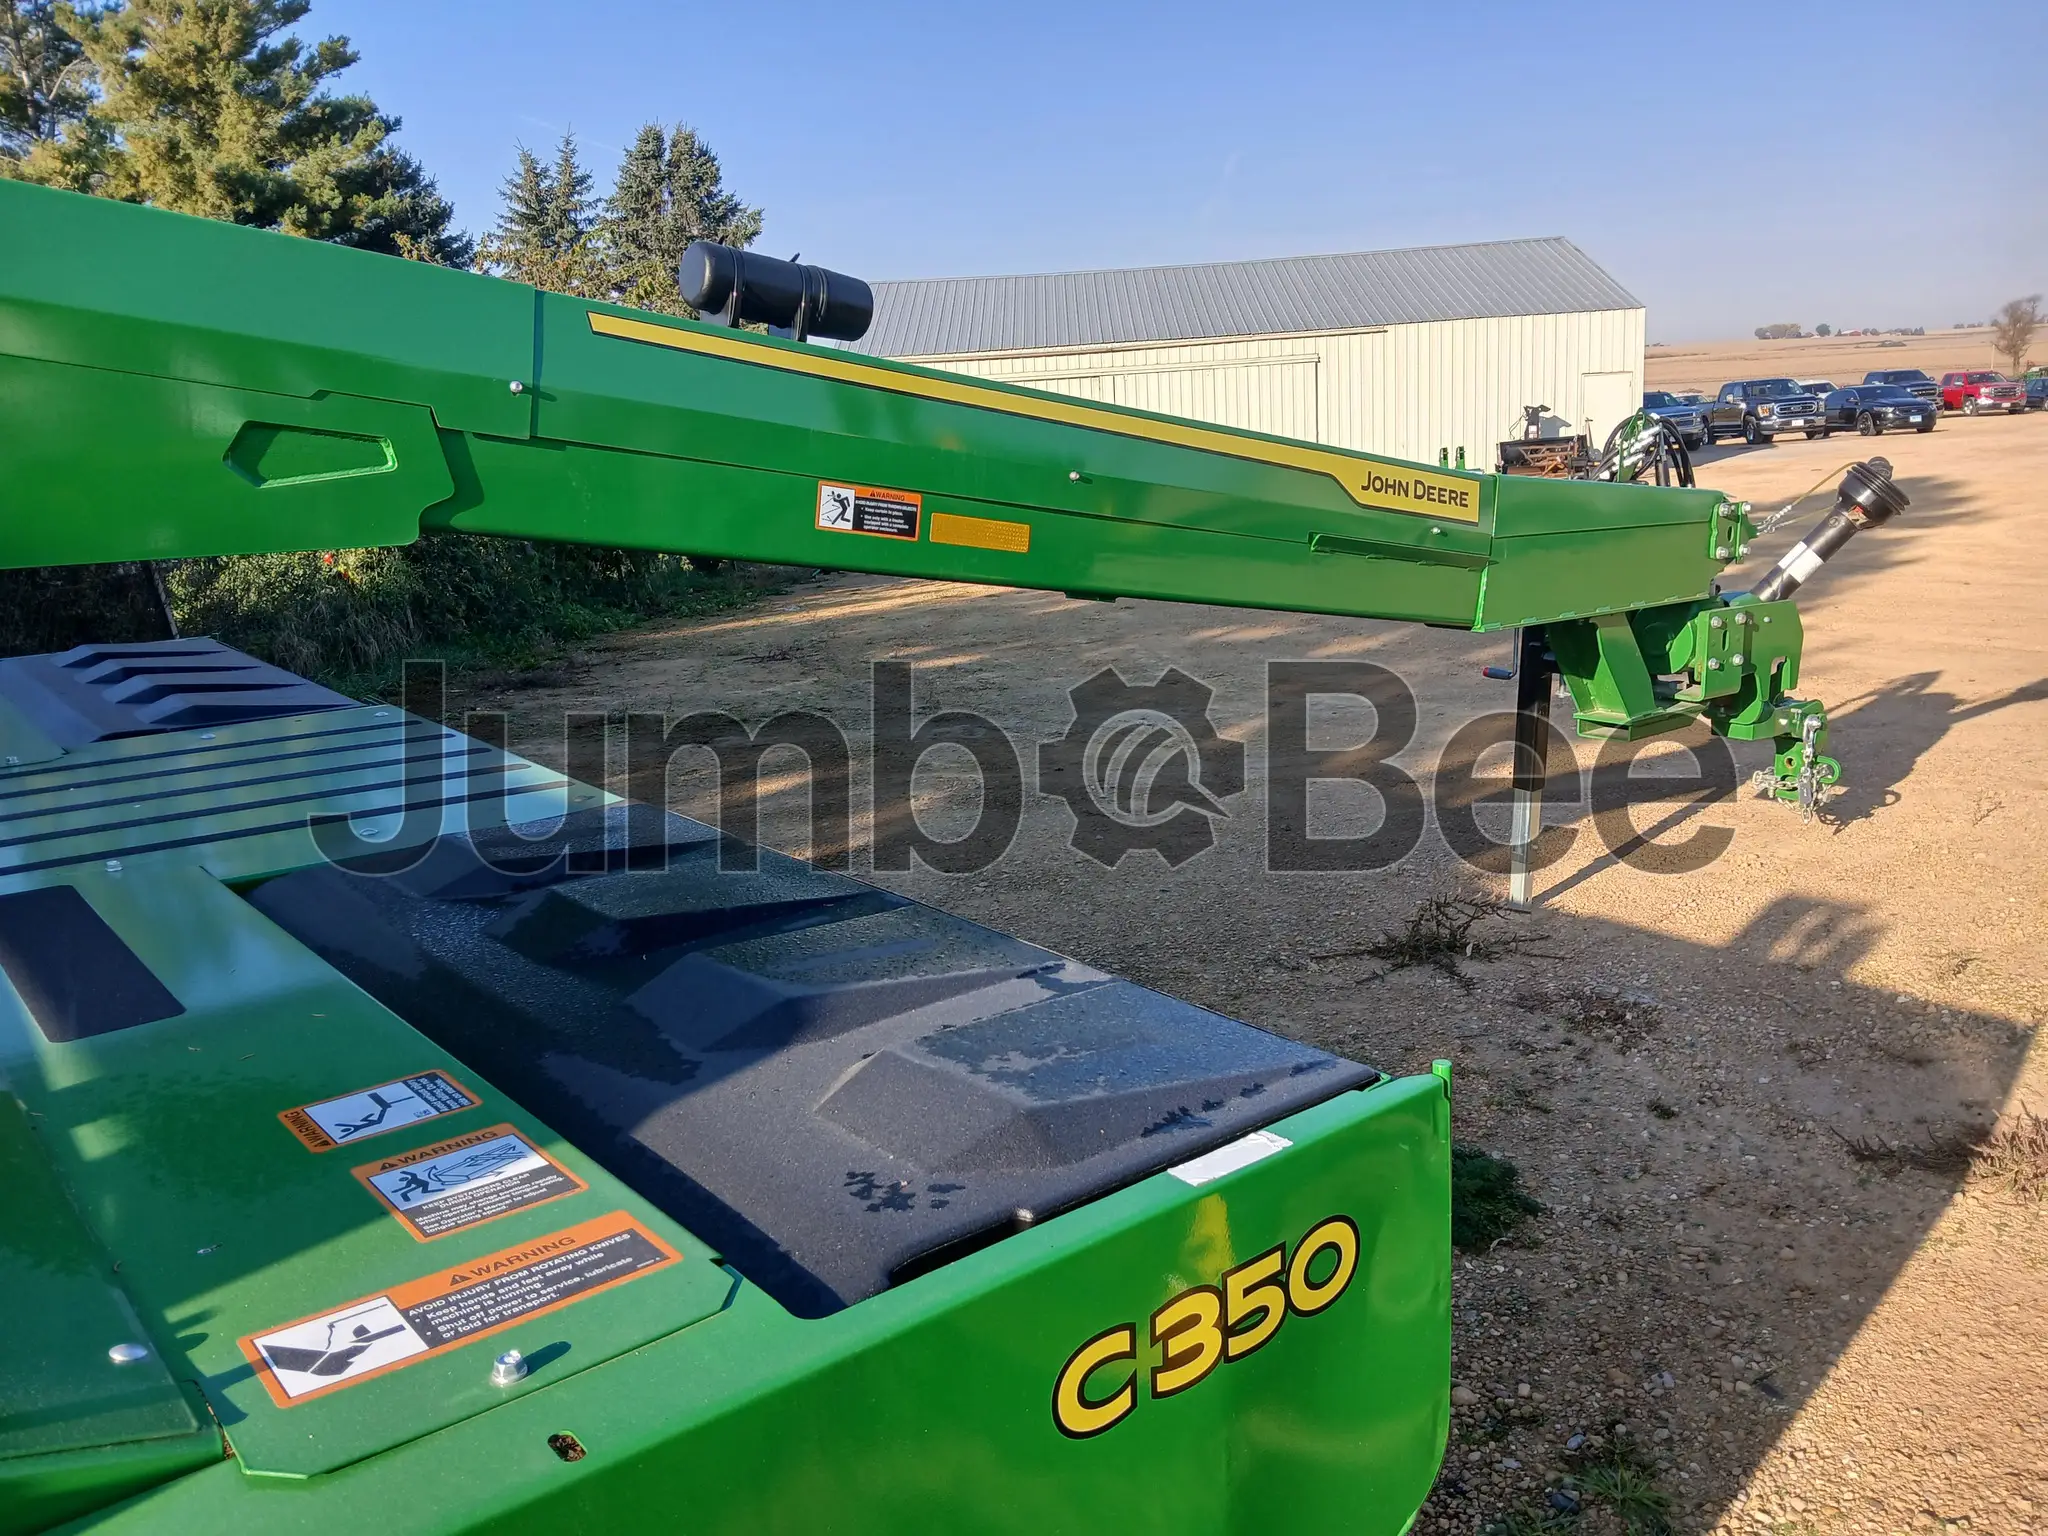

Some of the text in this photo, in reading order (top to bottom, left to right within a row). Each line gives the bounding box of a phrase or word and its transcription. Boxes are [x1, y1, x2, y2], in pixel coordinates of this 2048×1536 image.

[876, 491, 905, 501] WARNING
[1361, 471, 1469, 508] JOHN DEERE
[284, 1111, 321, 1147] WARNING
[397, 1131, 499, 1163] WARNING
[421, 1173, 531, 1209] KEEP BYSTANDERS CLEAR
[438, 1180, 521, 1208] DURING OPERATION
[414, 1208, 450, 1222] Machine
[449, 1203, 468, 1211] may
[417, 1216, 442, 1225] when
[422, 1222, 440, 1230] See
[406, 1233, 632, 1316] AVOID INJURY FROM ROTATING KNIVES
[470, 1237, 576, 1276] WARNING
[425, 1251, 605, 1320] Keep hands and feet away while
[429, 1280, 546, 1325] machine is running.
[436, 1317, 467, 1332] Shut
[467, 1310, 486, 1320] off
[486, 1297, 525, 1314] power
[524, 1291, 538, 1299] to
[538, 1274, 585, 1294] service,
[584, 1256, 634, 1277] lubricate
[442, 1291, 561, 1338] or fold for transport.
